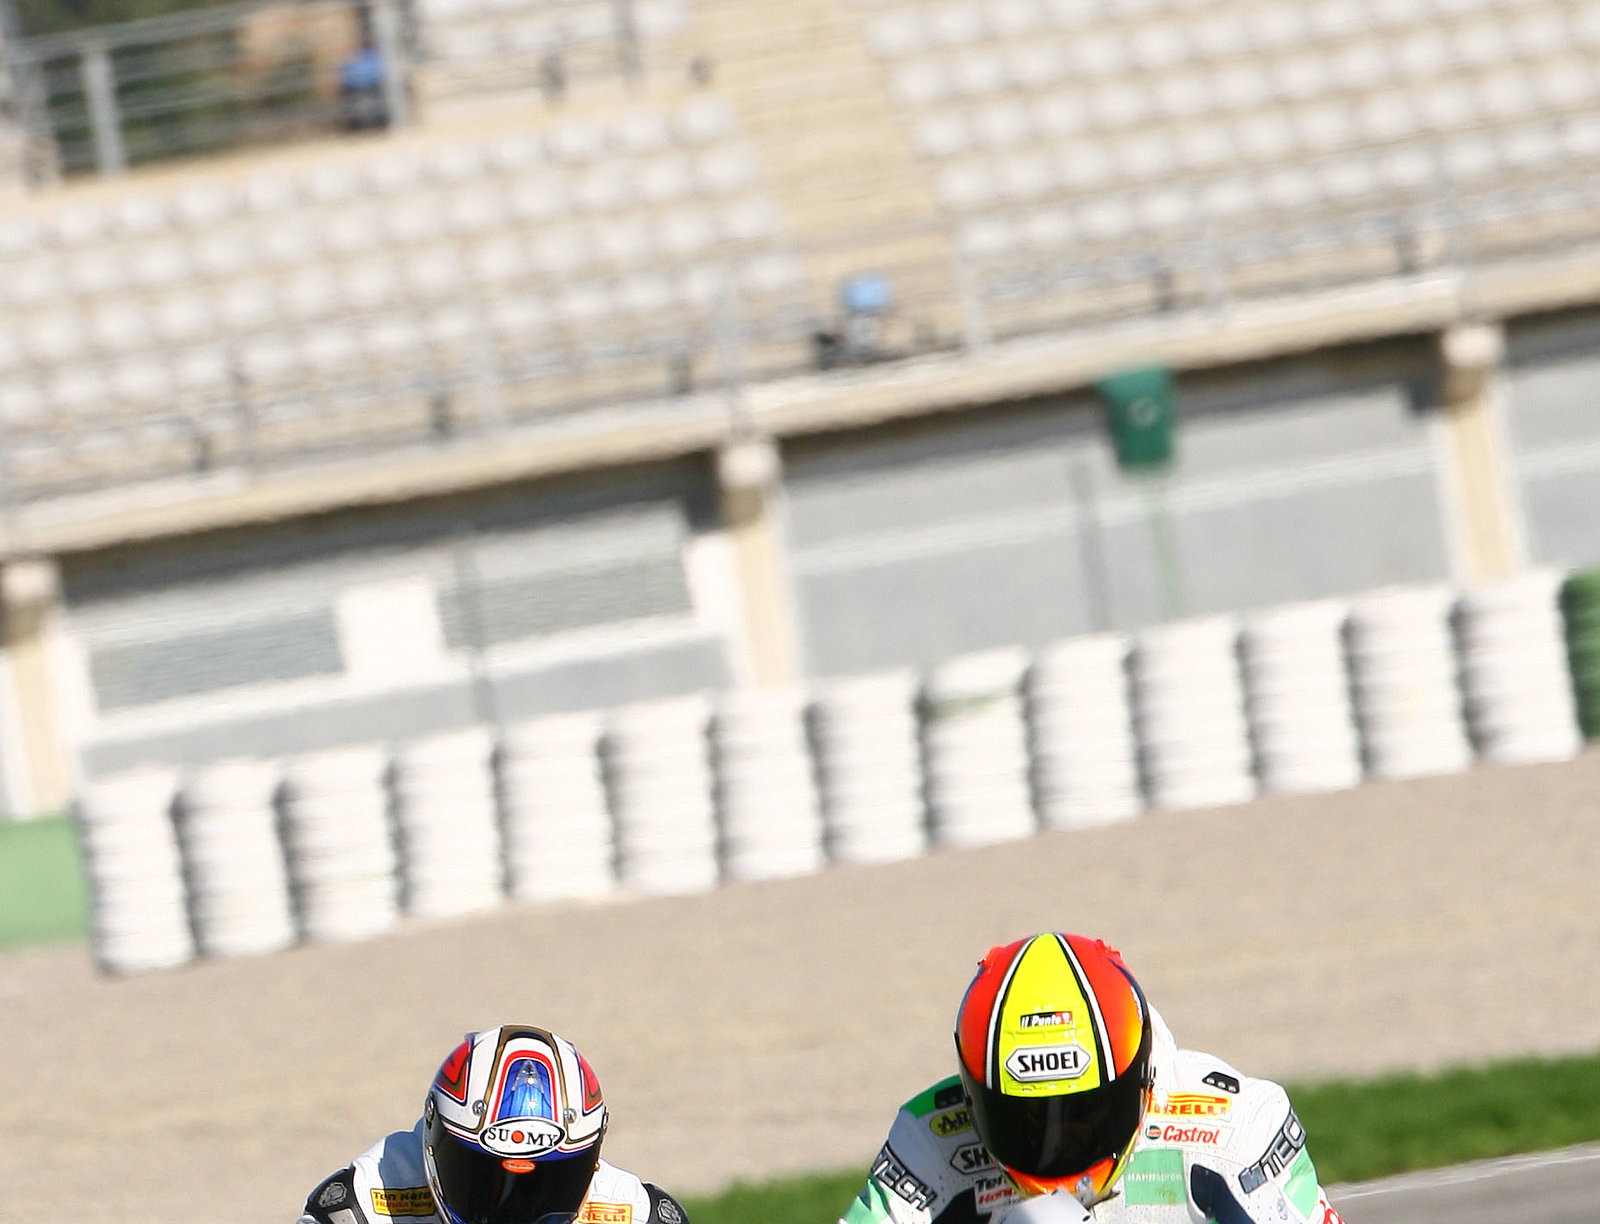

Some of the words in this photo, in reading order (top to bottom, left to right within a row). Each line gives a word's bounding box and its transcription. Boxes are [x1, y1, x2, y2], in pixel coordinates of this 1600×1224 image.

[1017, 1051, 1079, 1073] SHOEI
[487, 1128, 558, 1148] SUOMY
[1163, 1125, 1220, 1144] Castrol
